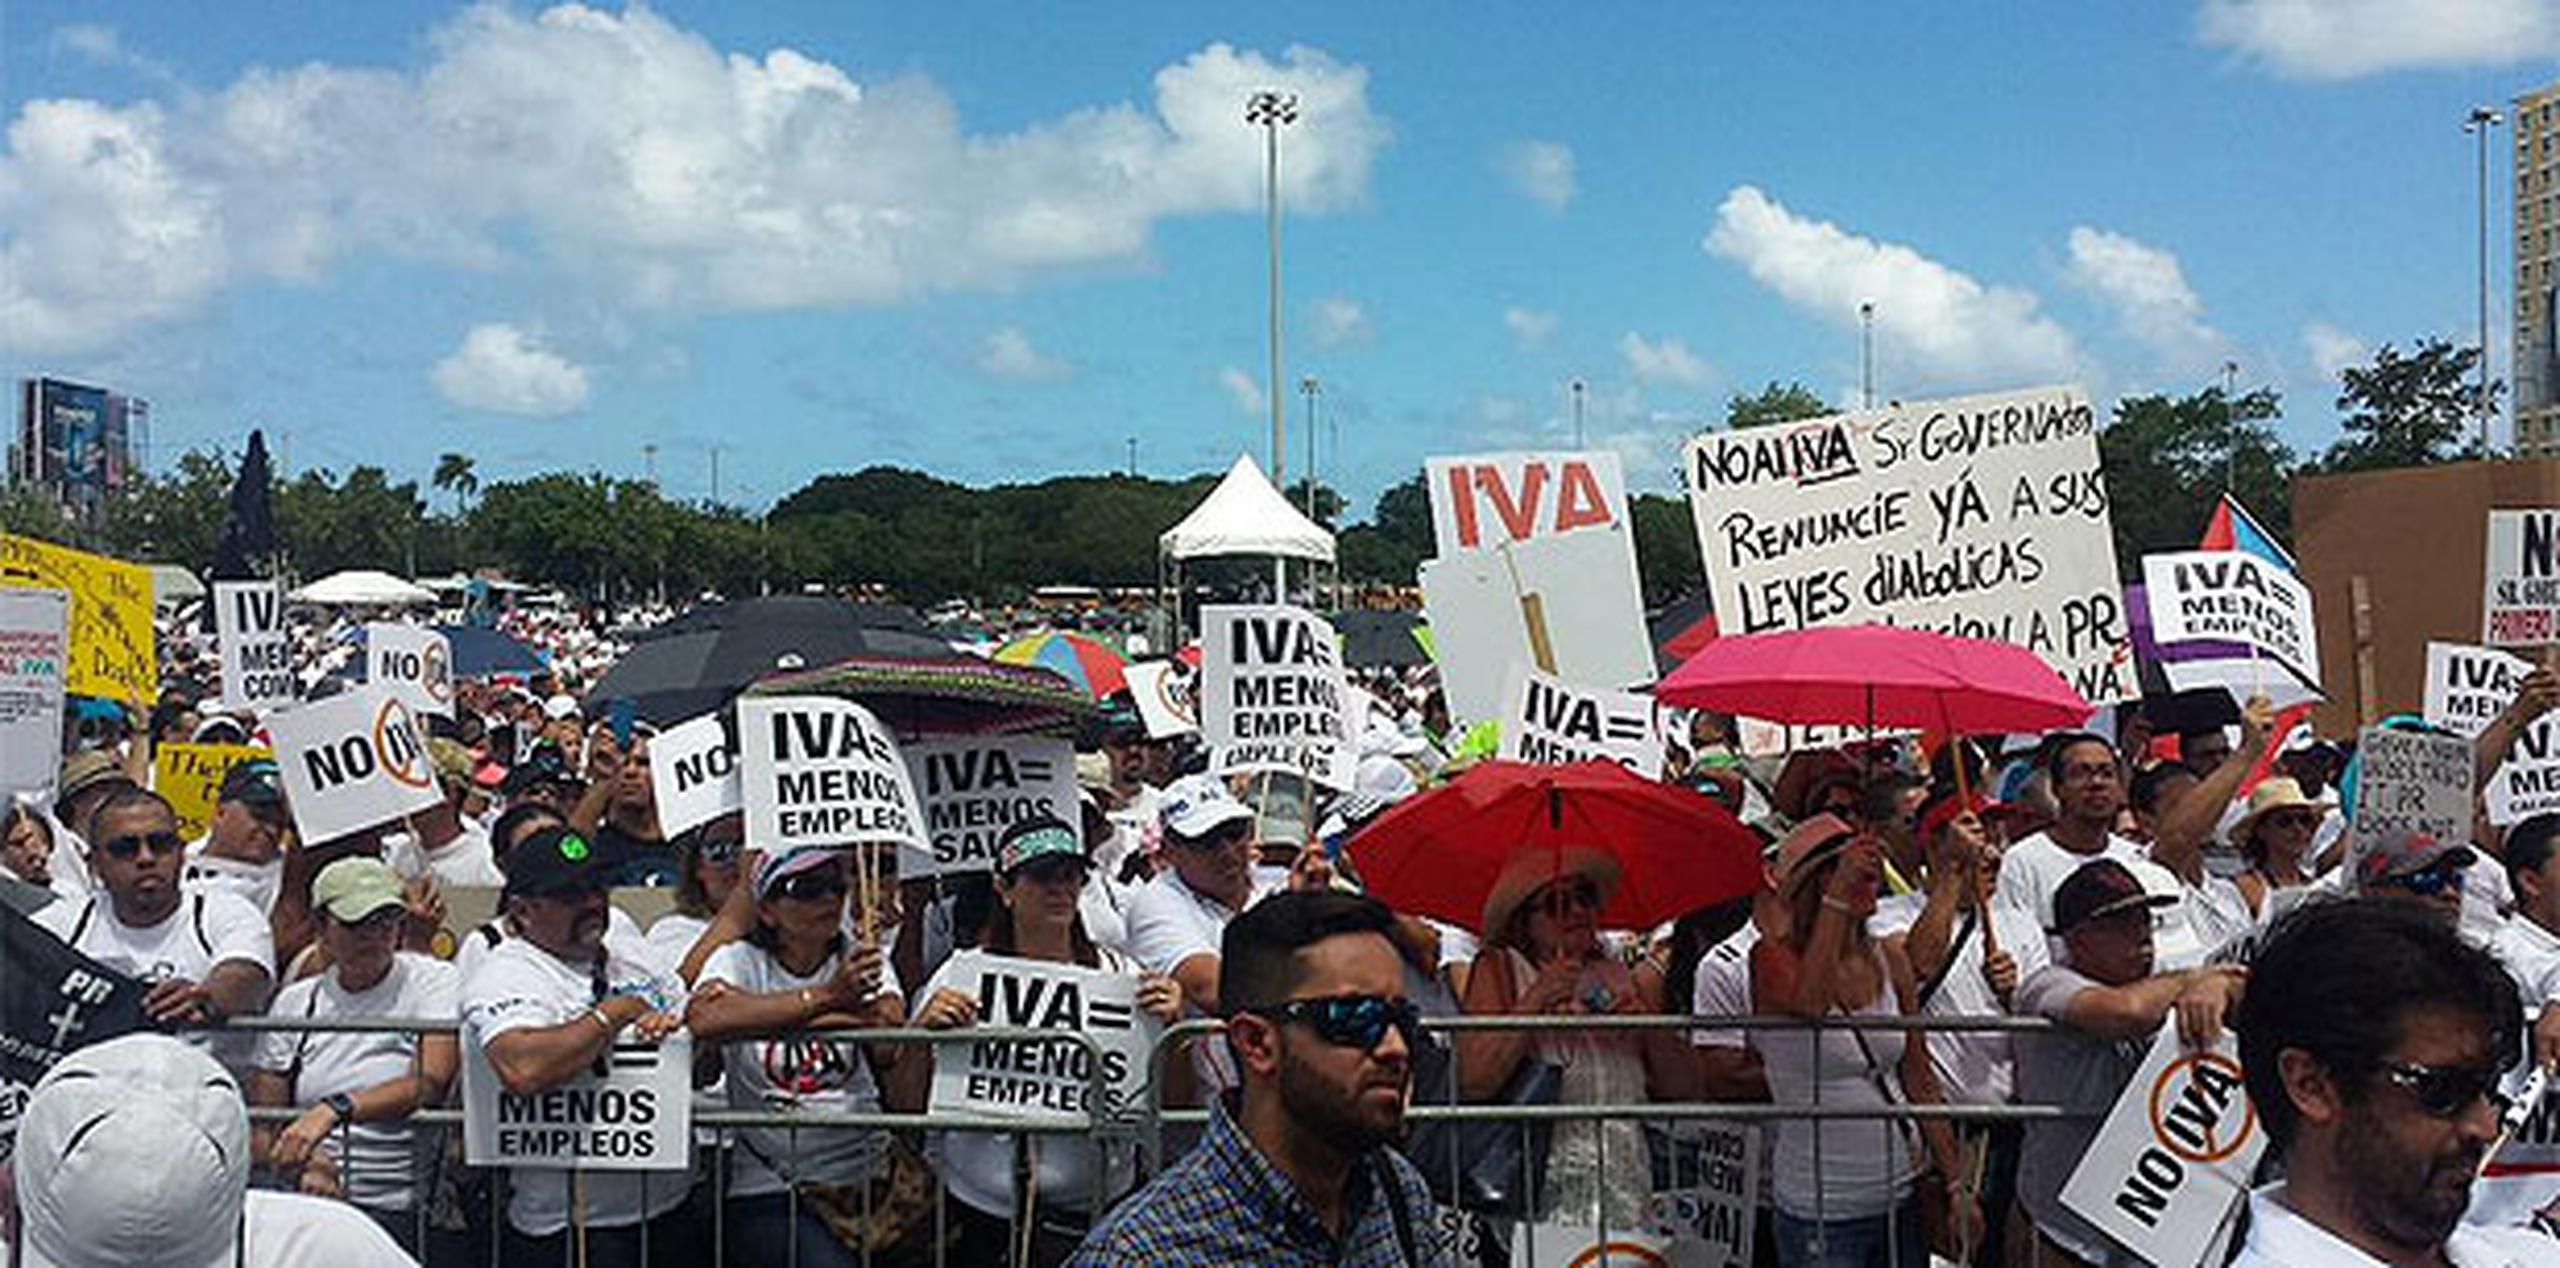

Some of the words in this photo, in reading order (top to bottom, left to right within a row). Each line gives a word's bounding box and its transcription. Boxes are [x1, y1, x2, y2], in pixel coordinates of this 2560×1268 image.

[1448, 461, 1615, 549] IVA
[2012, 476, 2039, 520] A
[2523, 513, 2560, 578] N
[2174, 560, 2296, 611] IVA=
[236, 591, 283, 633] IV
[2063, 595, 2125, 658] PR
[2181, 596, 2301, 643] MENOS
[381, 650, 420, 681] NO
[1232, 618, 1331, 667] IVA=
[1524, 680, 1646, 743] IVA=
[771, 711, 893, 764] IVA=
[303, 734, 377, 792] NO
[673, 745, 734, 792] NO
[926, 748, 1053, 796] IVA=
[777, 770, 906, 809] MENOS
[930, 796, 1054, 830] MENOS
[976, 972, 1133, 1032] IVA=
[969, 1037, 1128, 1084] MENOS
[498, 1087, 656, 1125] MENOS
[2164, 1063, 2243, 1149] IVA
[498, 1129, 655, 1158] EMPLEOS
[2113, 1146, 2185, 1229] NO
